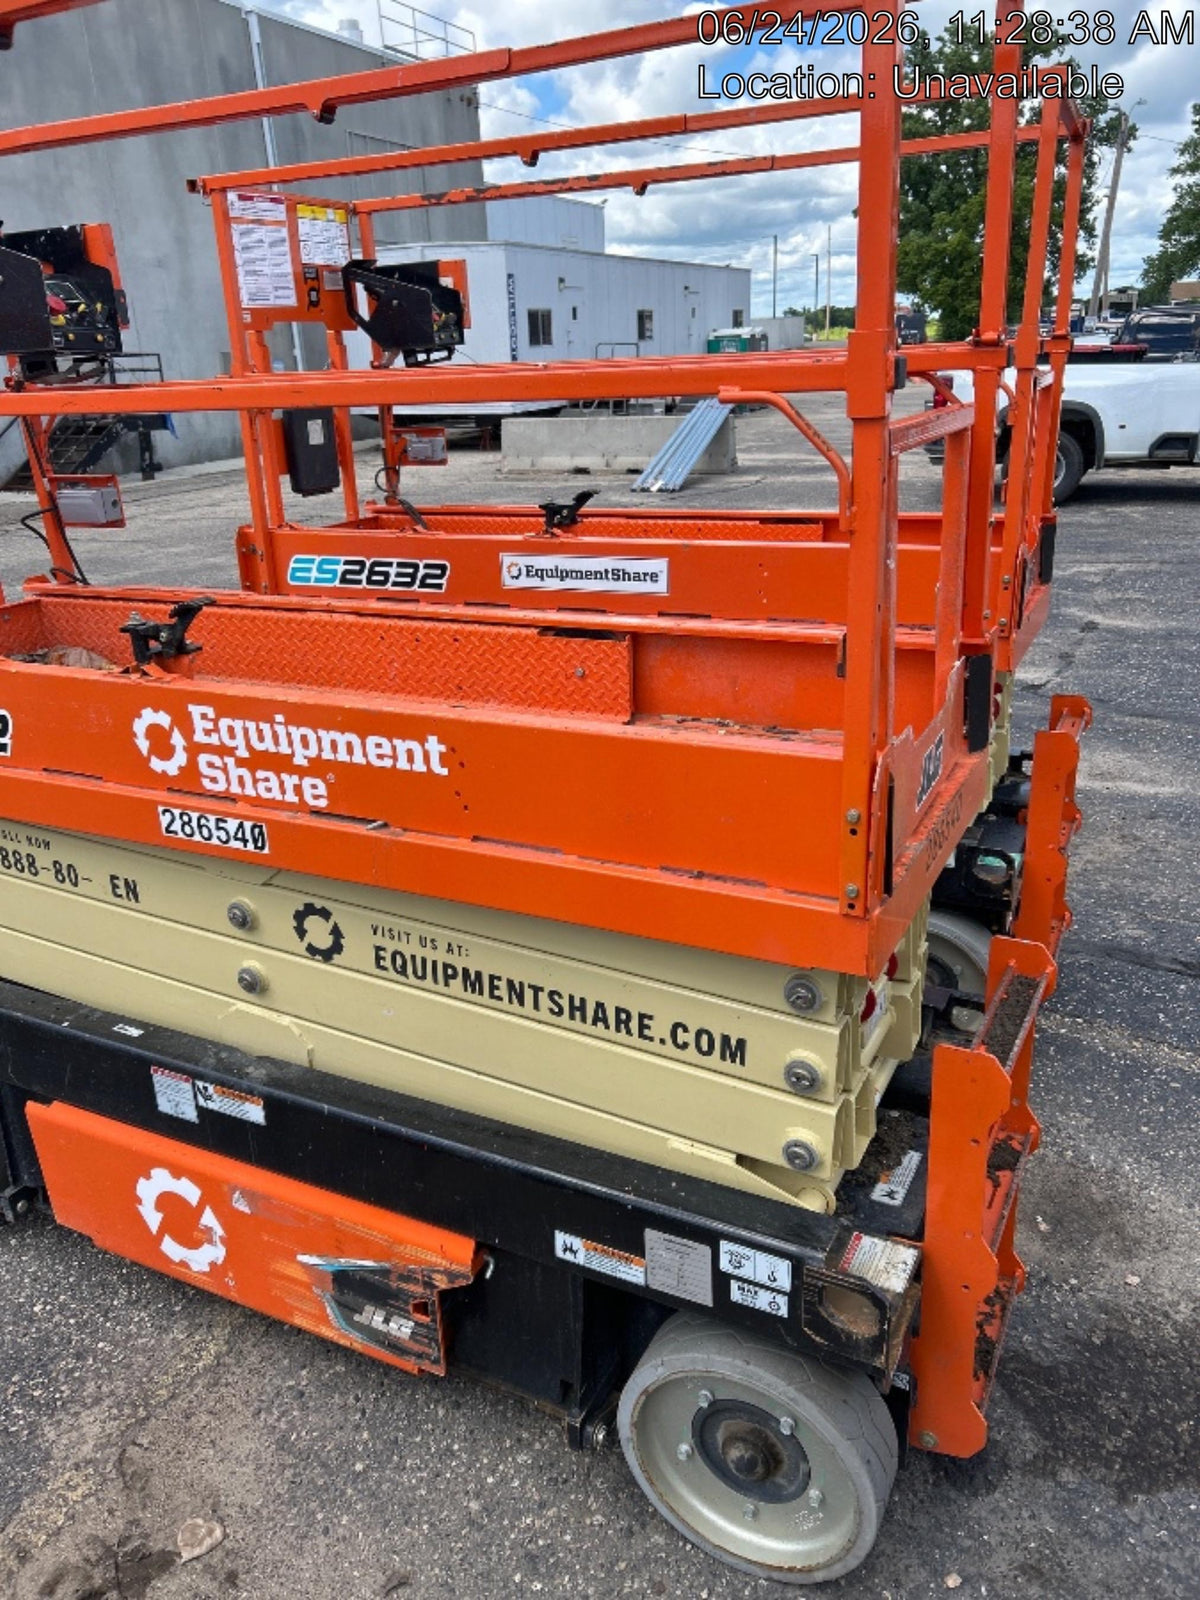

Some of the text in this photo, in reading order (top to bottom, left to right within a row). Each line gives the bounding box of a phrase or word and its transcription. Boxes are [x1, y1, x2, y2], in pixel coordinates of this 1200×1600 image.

[289, 556, 448, 591] ES2632
[525, 565, 660, 584] EquipmentShare
[188, 705, 448, 775] Equipment
[197, 754, 329, 808] Share
[161, 808, 267, 851] 286540
[371, 924, 470, 957] VISIT US AT:
[373, 944, 748, 1067] EQUIPMENTSHARE.COM
